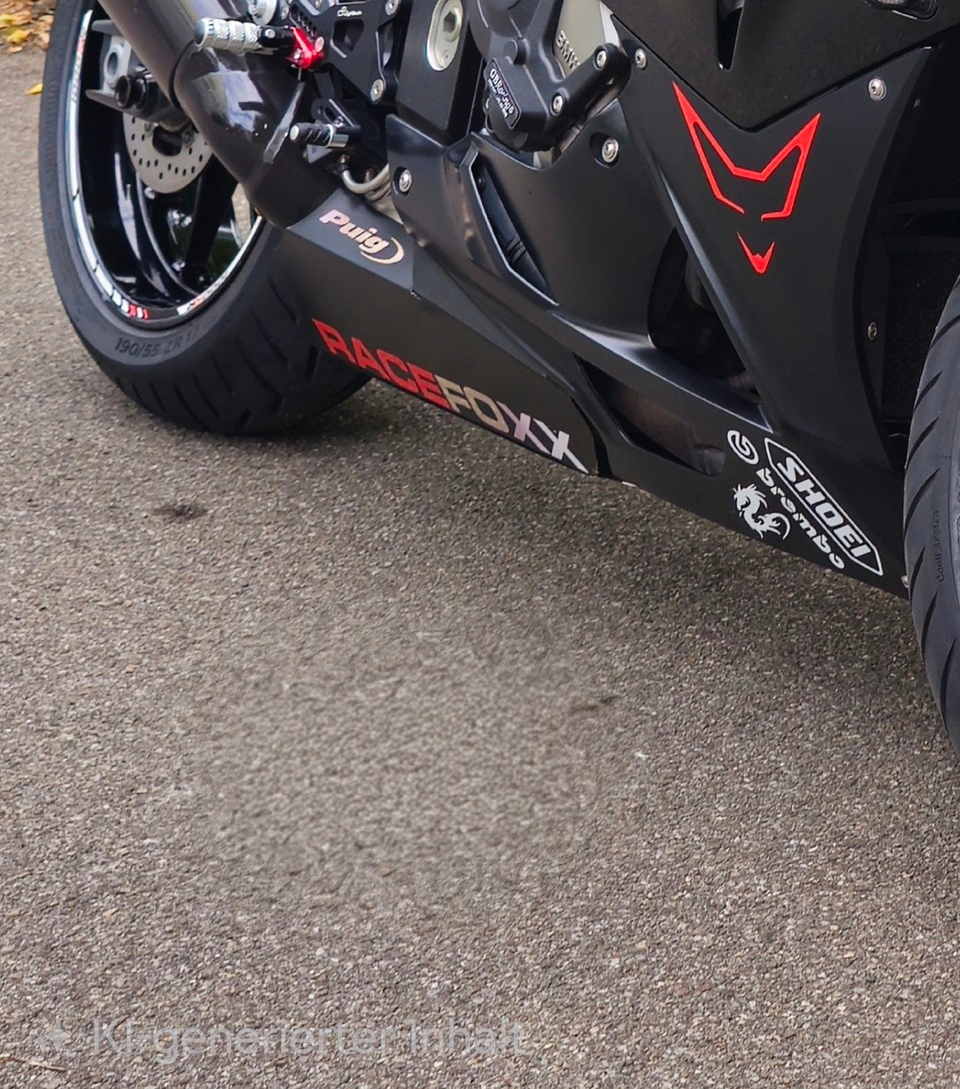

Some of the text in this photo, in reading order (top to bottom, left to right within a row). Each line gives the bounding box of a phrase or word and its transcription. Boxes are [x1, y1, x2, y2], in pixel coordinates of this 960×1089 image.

[319, 209, 400, 261] Puig
[114, 337, 159, 358] 190/55
[312, 318, 589, 474] RACEFOXX
[756, 467, 845, 569] brembo
[777, 457, 872, 558] SHOEI
